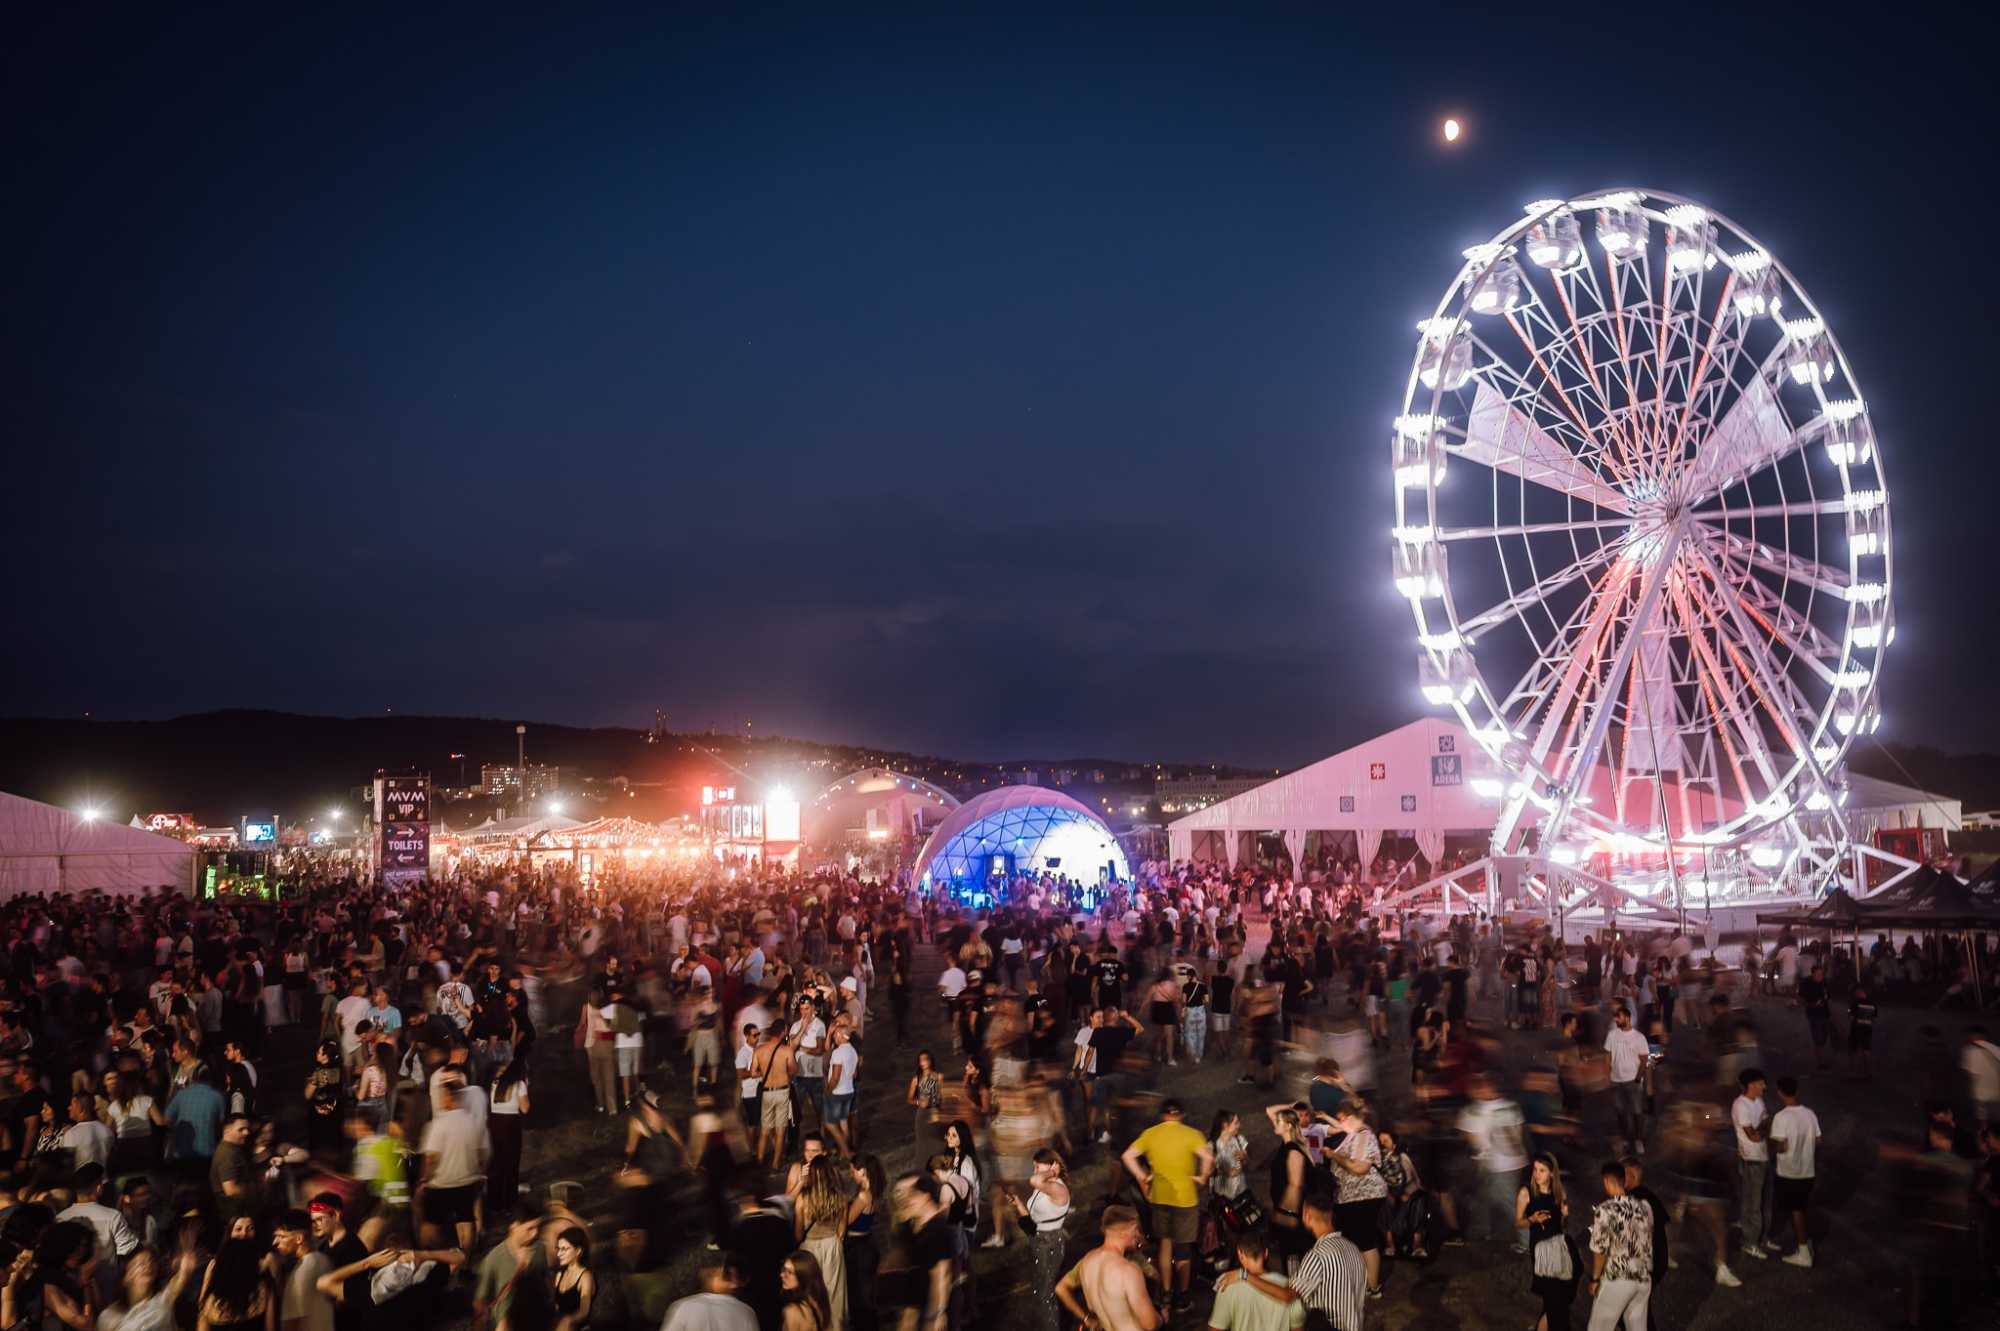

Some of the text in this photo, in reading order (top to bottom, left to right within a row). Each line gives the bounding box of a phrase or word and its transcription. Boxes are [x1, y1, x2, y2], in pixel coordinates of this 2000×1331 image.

[1434, 775, 1462, 785] ARENA
[387, 791, 425, 801] MVM
[398, 804, 414, 815] VIP
[388, 840, 424, 851] TOILETS
